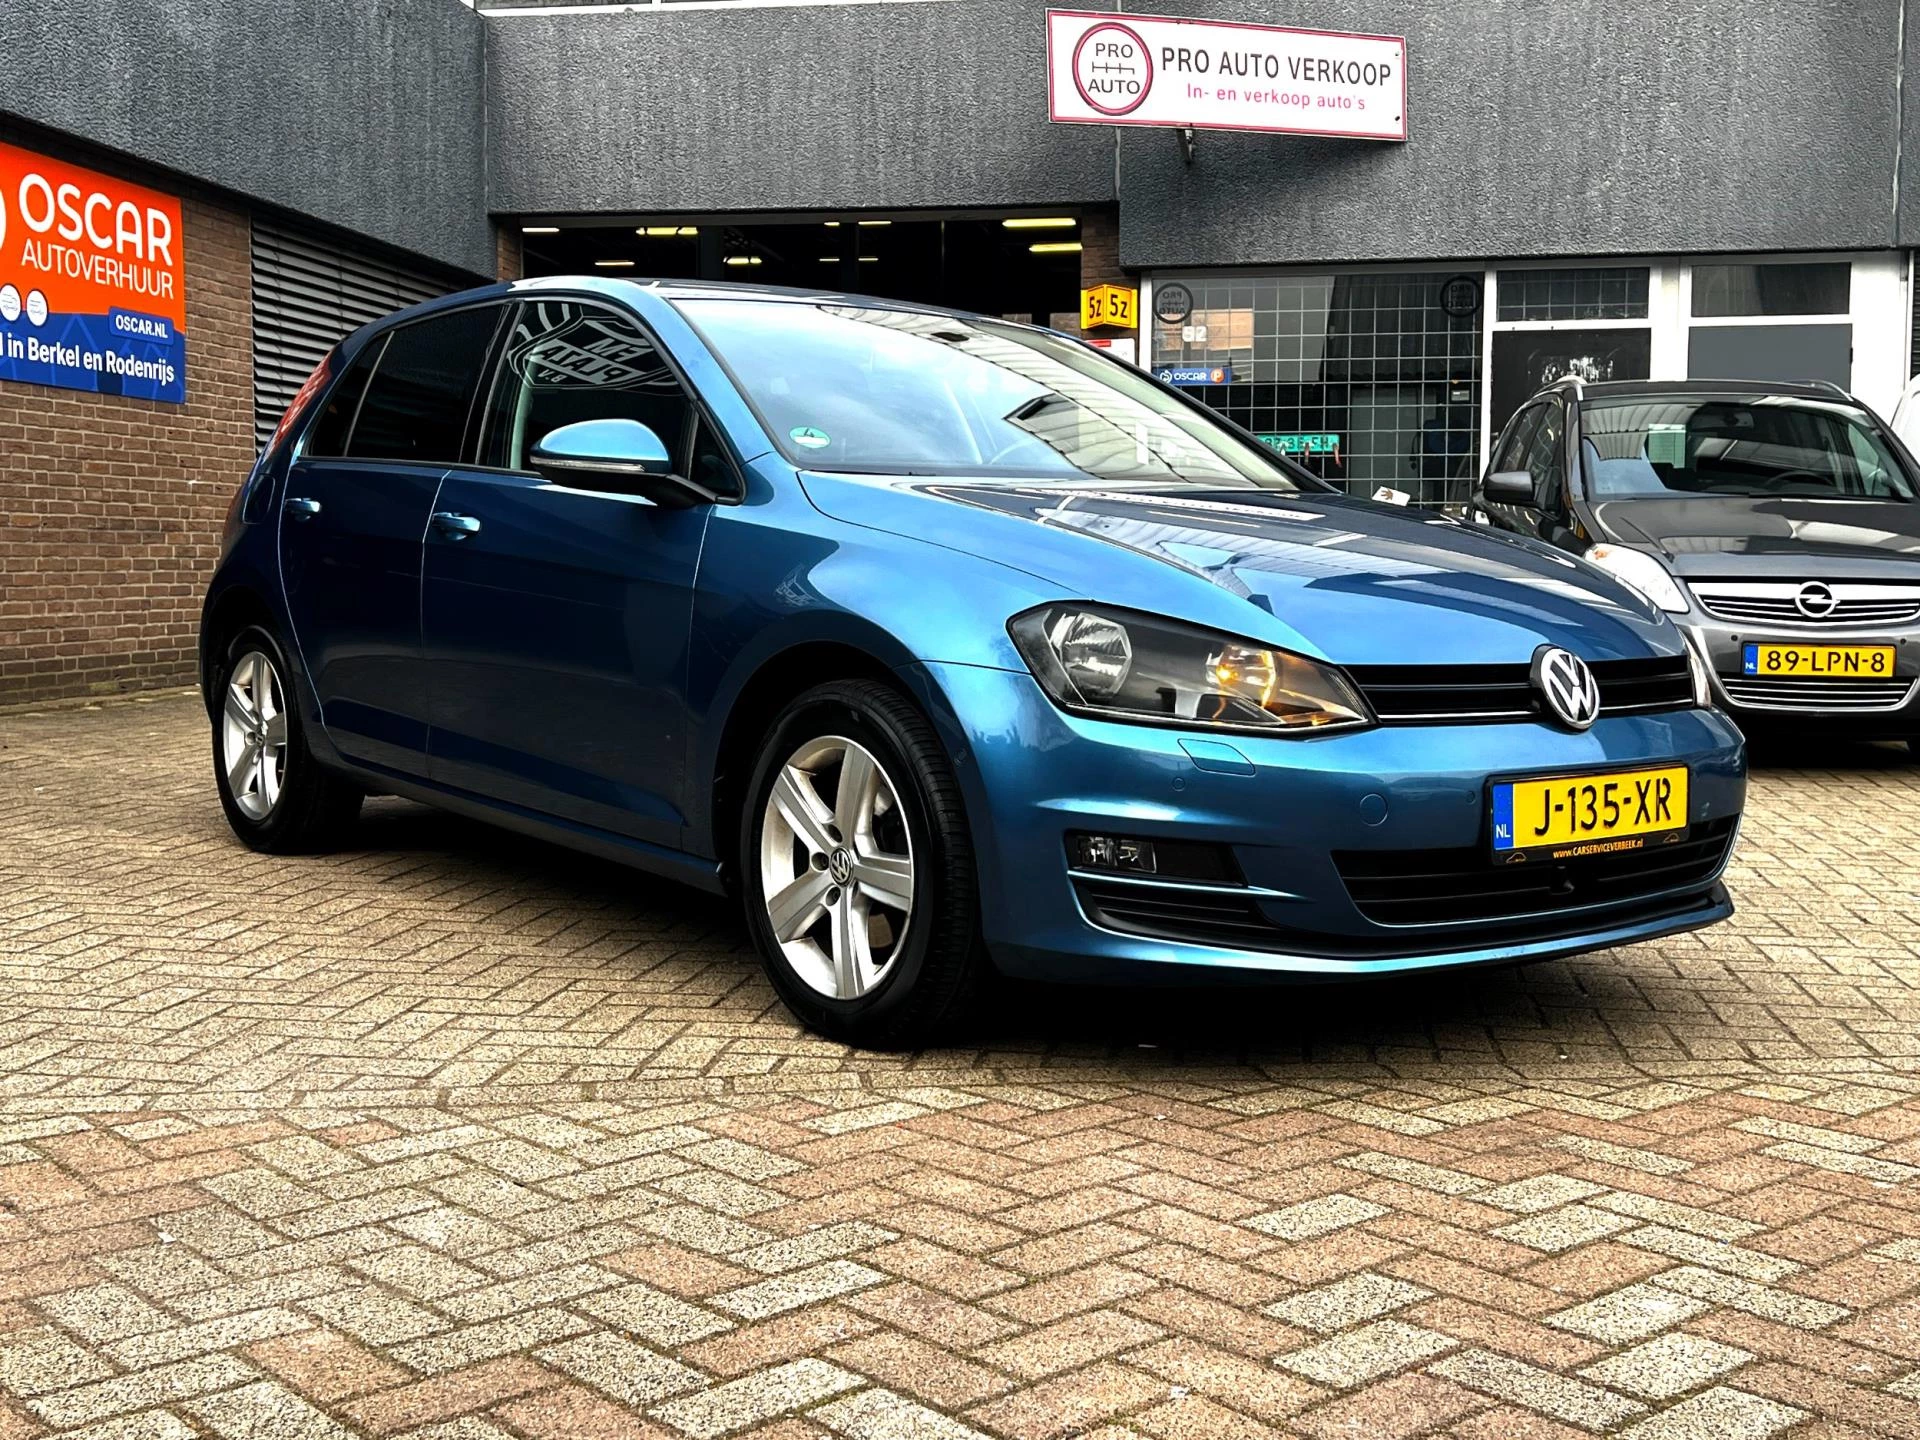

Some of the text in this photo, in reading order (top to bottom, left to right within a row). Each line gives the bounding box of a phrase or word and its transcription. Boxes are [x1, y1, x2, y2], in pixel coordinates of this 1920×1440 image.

[1096, 43, 1133, 58] PRO
[1162, 47, 1391, 86] PRO AUTO VERKOOP
[1088, 79, 1140, 94] AUTO
[1187, 83, 1209, 98] In-
[1217, 88, 1236, 101] en
[1244, 89, 1310, 109] verkoop
[19, 173, 173, 266] OSCAR
[21, 238, 174, 300] AUTOVERHUUR
[116, 314, 168, 339] OSCAR.NL
[7, 332, 23, 359] in
[28, 337, 80, 368] Berkel
[83, 353, 103, 371] en
[106, 351, 174, 386] Rodenrijs
[1174, 372, 1207, 381] OSCAR
[1745, 650, 1885, 673] NL 89-LPN-8
[1495, 777, 1672, 839] NL J-135-XR
